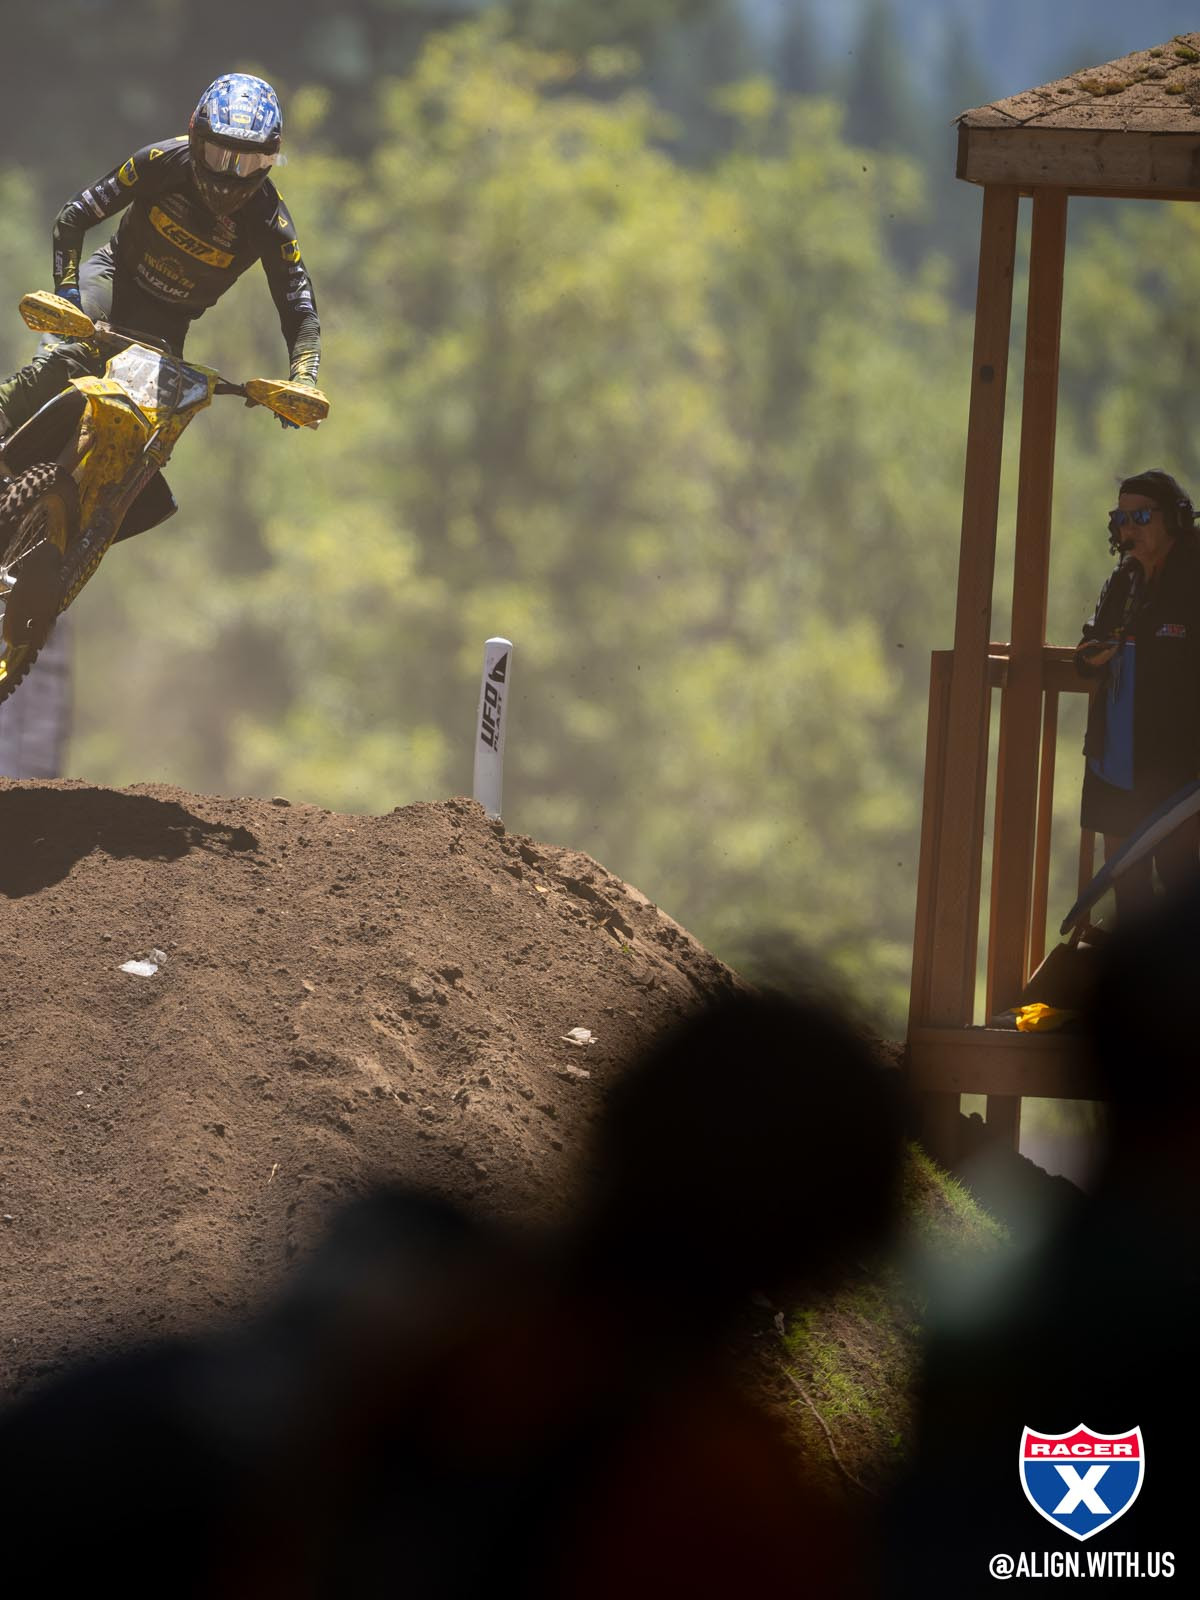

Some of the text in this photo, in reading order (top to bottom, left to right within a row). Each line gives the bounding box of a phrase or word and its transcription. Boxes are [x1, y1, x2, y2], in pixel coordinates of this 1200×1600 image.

[161, 224, 214, 256] LEATT
[136, 263, 190, 298] SUZUKI
[481, 683, 498, 747] UFO
